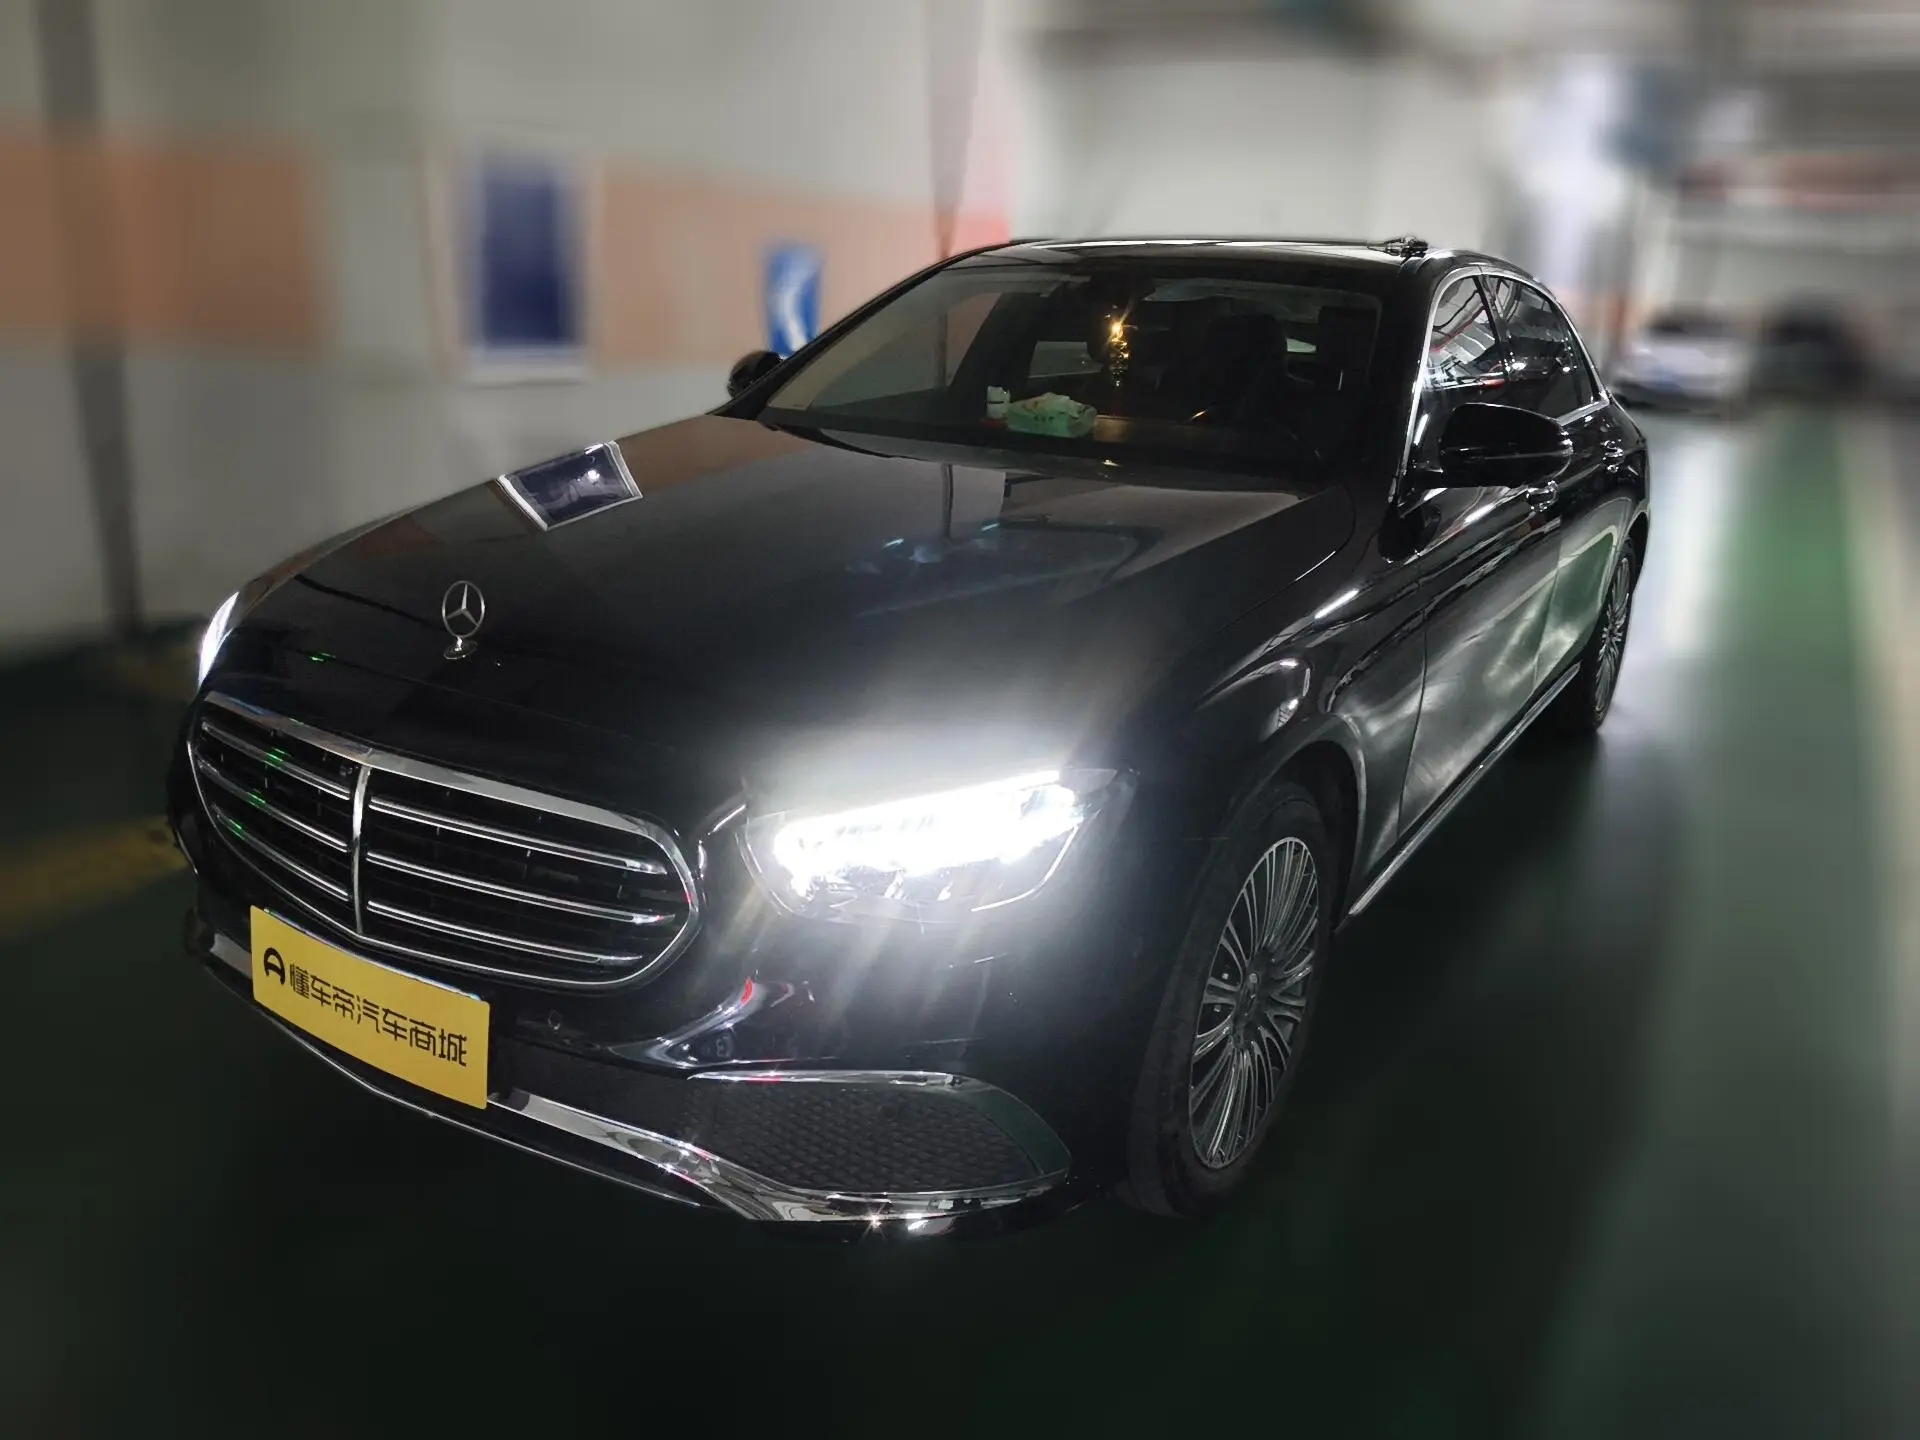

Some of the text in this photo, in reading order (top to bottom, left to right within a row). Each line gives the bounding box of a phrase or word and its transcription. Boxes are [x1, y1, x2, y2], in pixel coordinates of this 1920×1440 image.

[289, 962, 468, 1067] 懂车帝汽车商城
